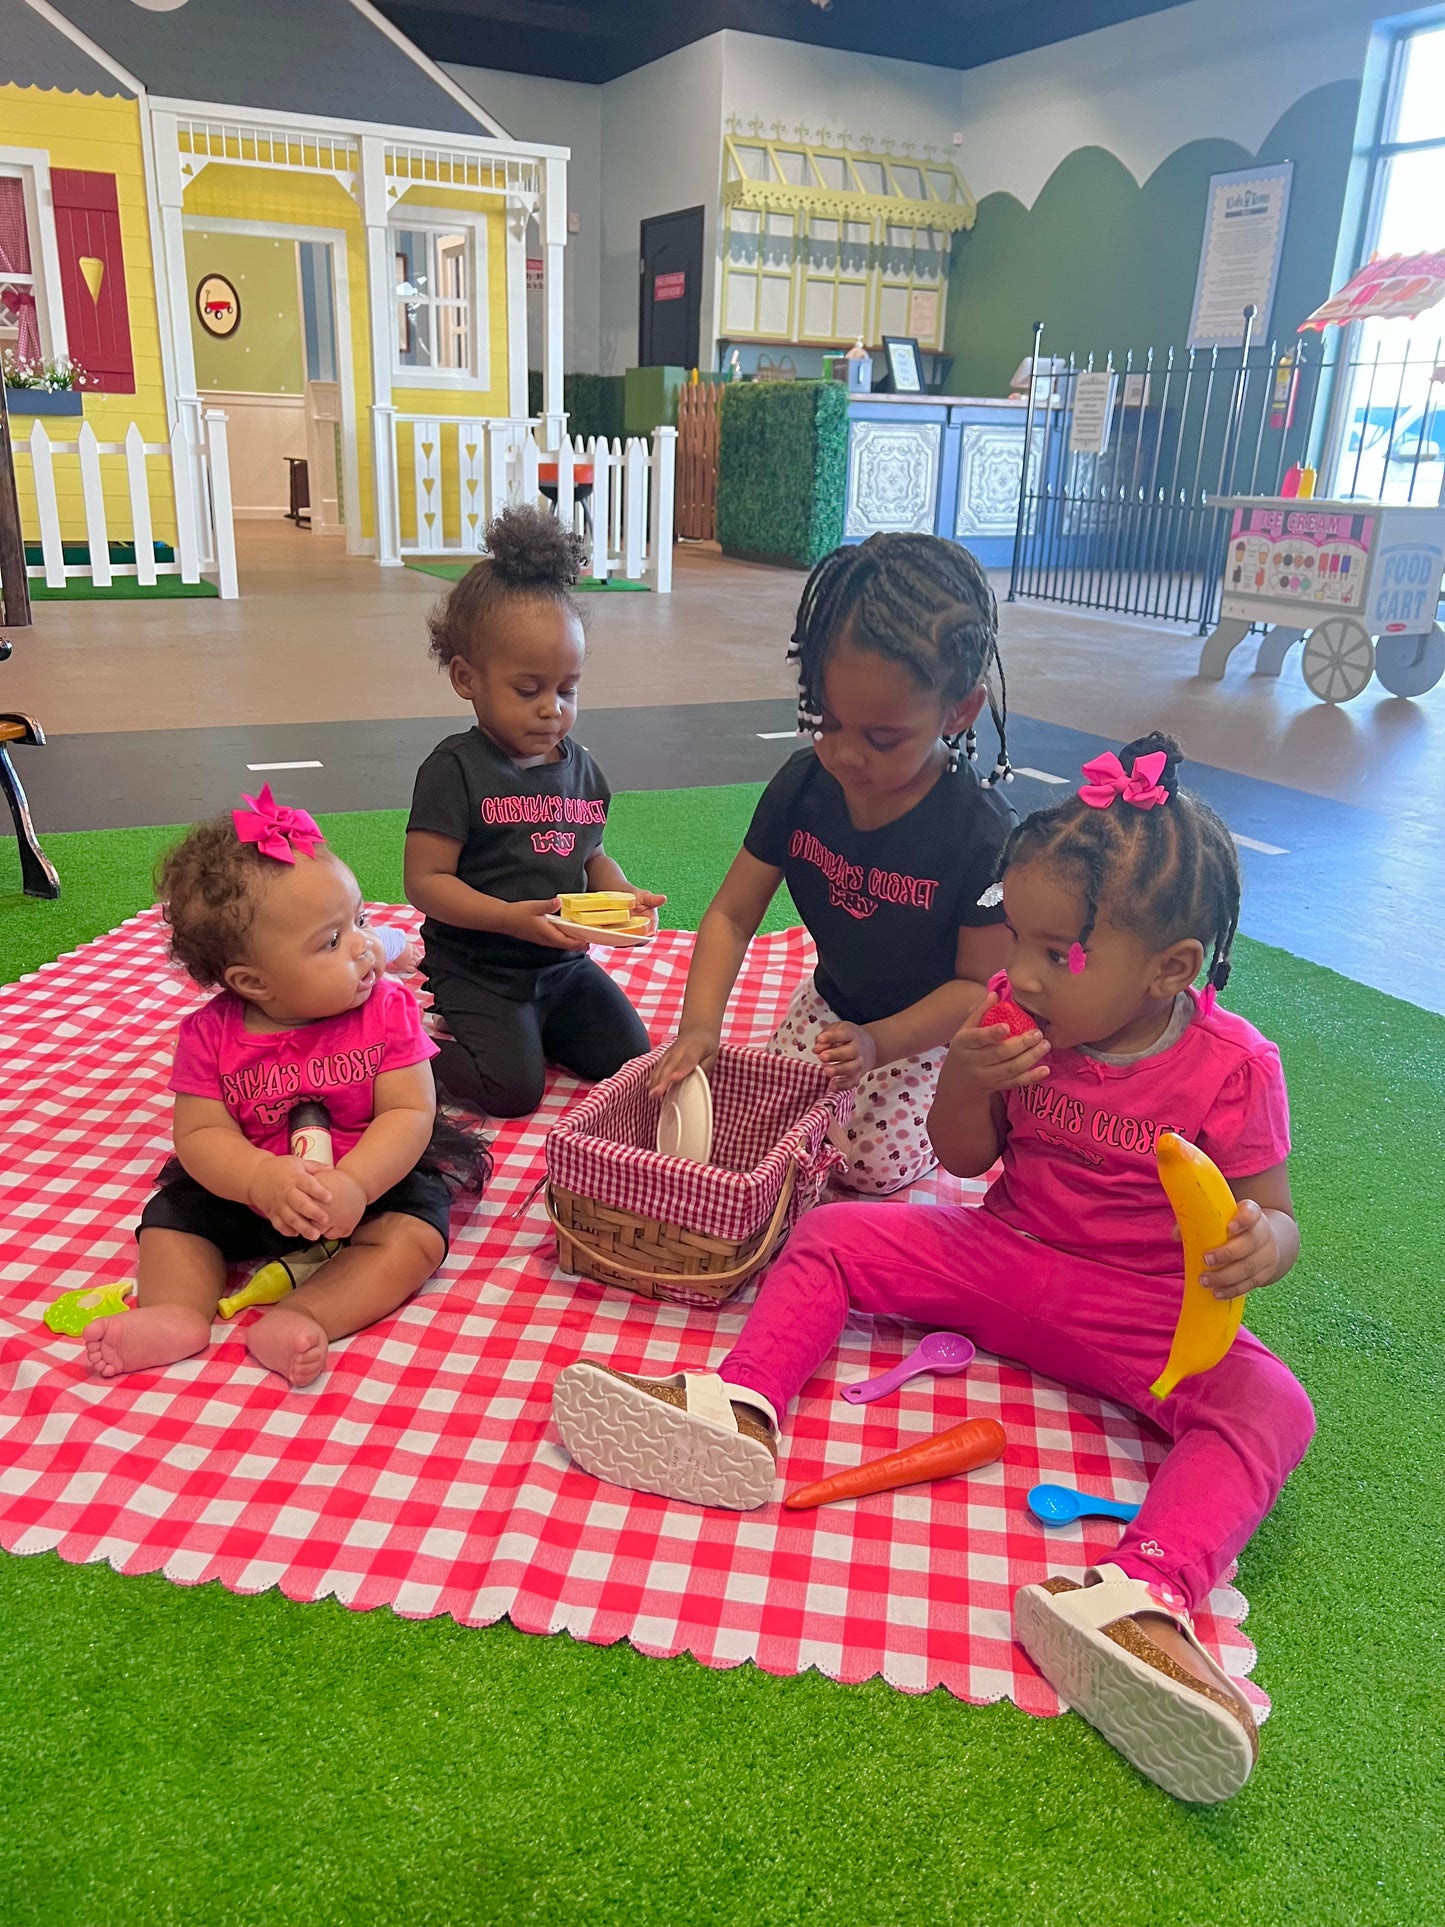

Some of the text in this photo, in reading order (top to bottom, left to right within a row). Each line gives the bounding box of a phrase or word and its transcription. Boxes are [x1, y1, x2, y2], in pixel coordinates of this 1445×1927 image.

[1261, 509, 1341, 534] ICE CREAM
[1382, 553, 1432, 588] FOOD
[1376, 590, 1427, 620] CART
[868, 867, 941, 912] CLOSET
[222, 1042, 386, 1106] SHYA'S CLOSET
